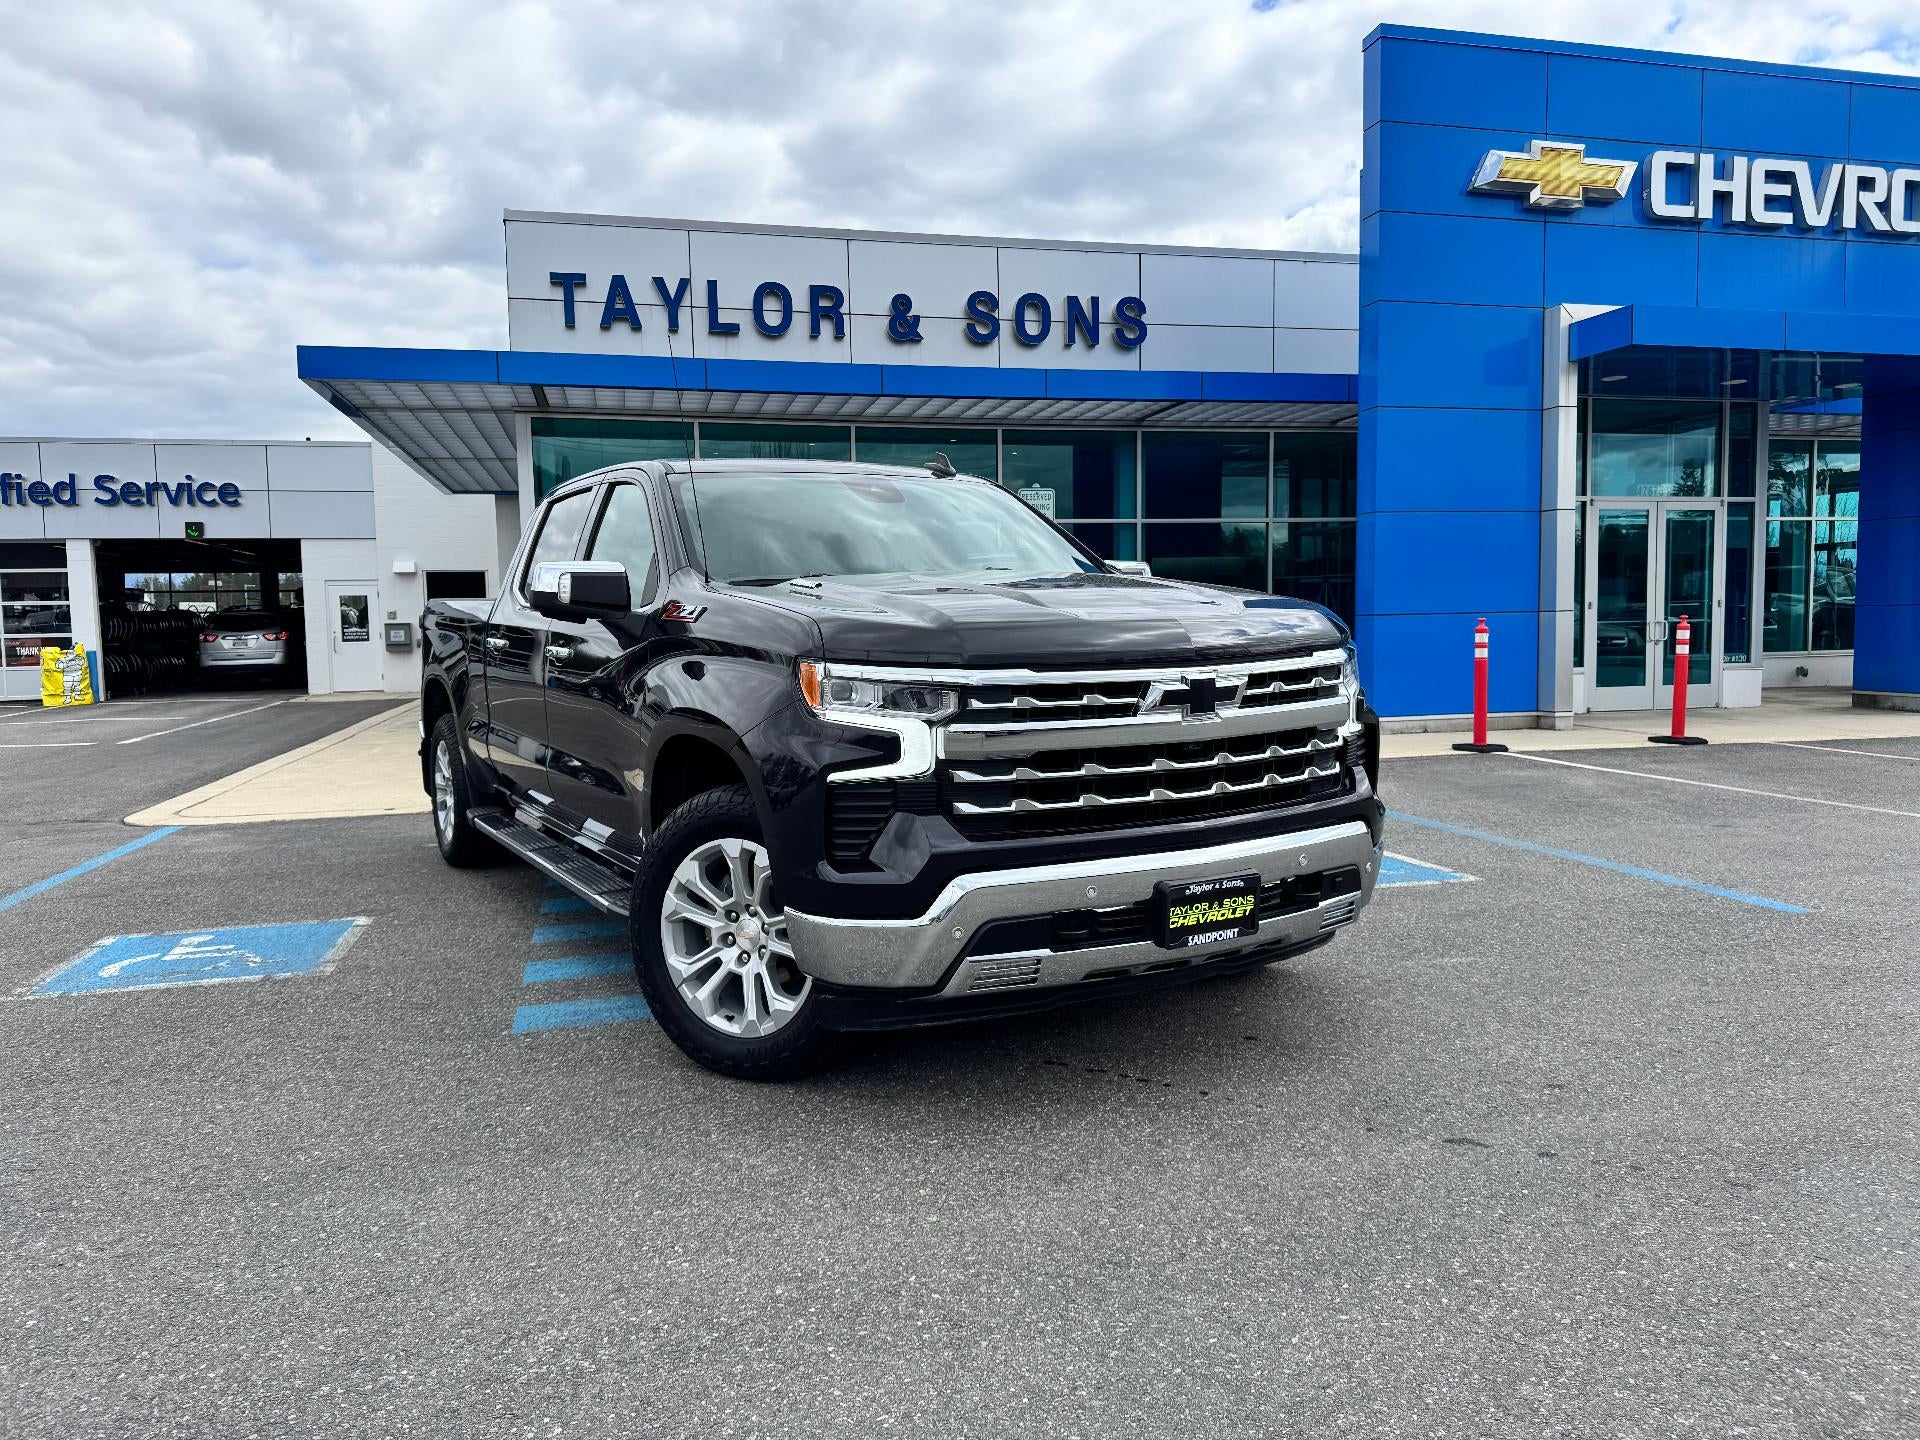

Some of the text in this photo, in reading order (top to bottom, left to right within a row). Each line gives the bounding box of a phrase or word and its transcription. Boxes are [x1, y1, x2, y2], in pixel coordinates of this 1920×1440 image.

[549, 272, 1148, 348] TAYLOR & SONS
[94, 474, 241, 507] Service
[1021, 493, 1052, 501] RESERVED
[15, 646, 40, 656] THANK
[1188, 883, 1214, 895] Taylor
[1222, 880, 1241, 889] Sons
[1169, 895, 1255, 917] TAYLOR & SONS
[1169, 906, 1254, 929] CHEVROLET
[1187, 928, 1240, 946] SANDPOINT
